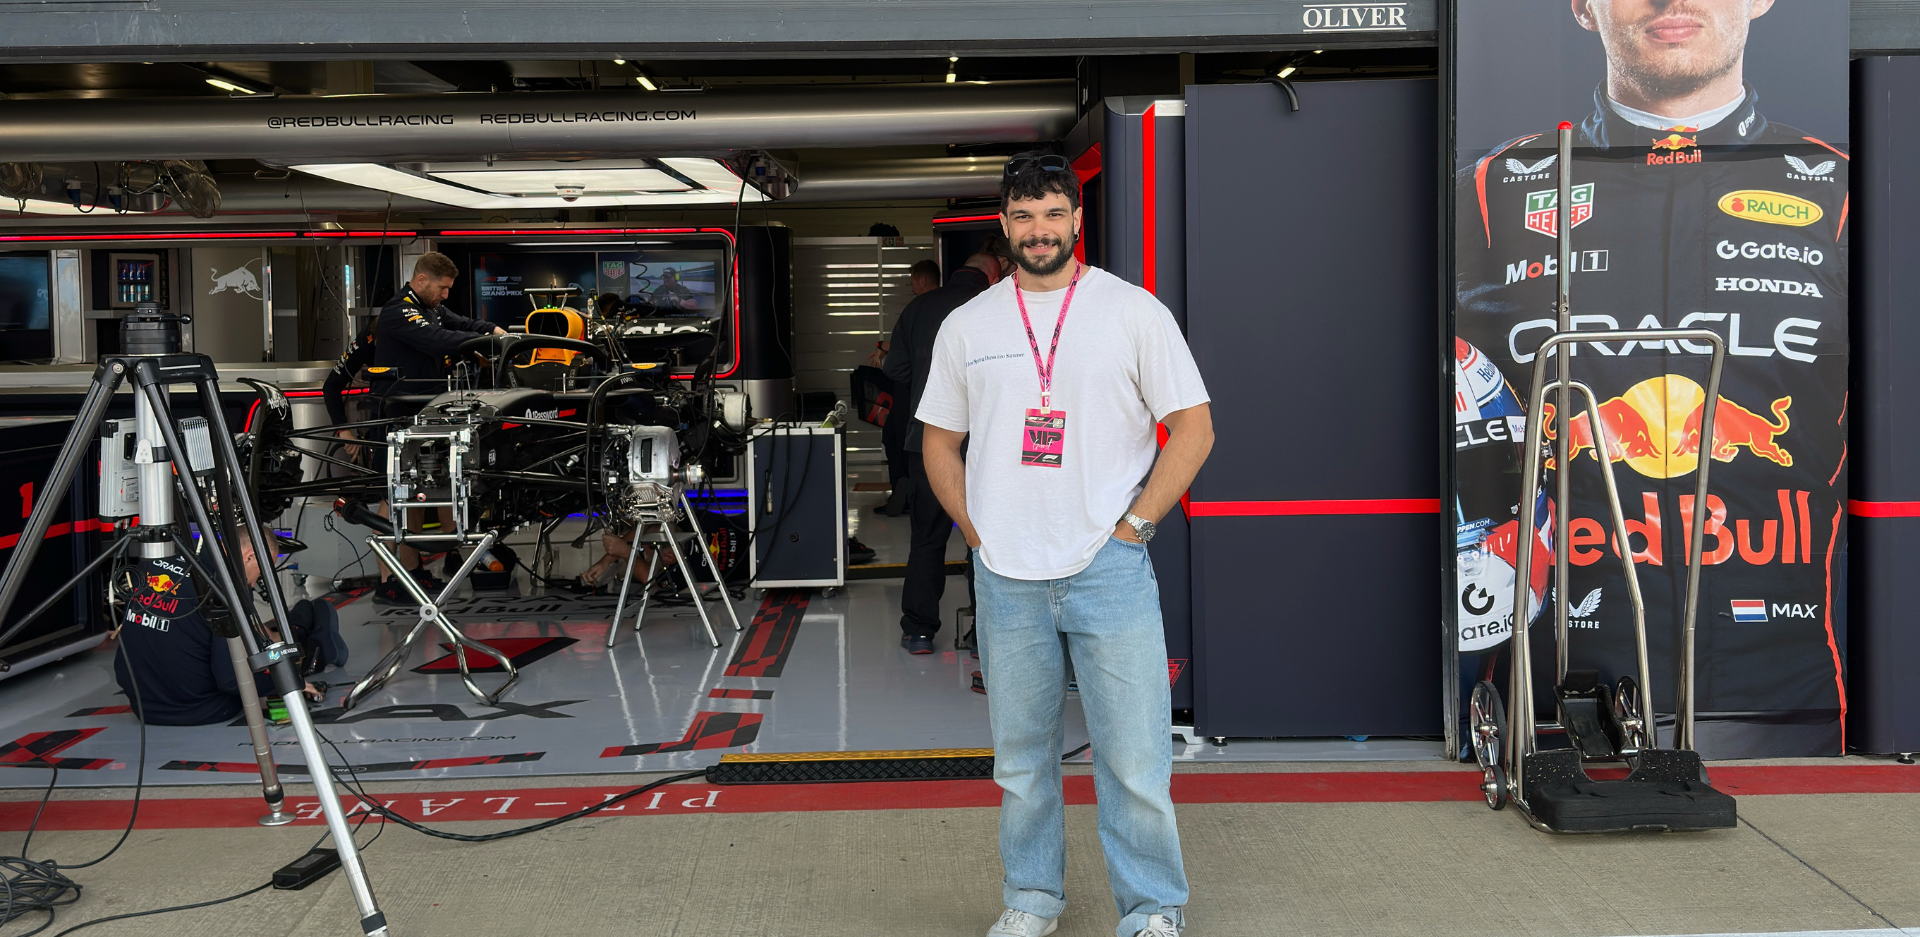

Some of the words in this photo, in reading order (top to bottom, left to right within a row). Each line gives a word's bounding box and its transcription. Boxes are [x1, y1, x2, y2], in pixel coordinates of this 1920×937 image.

[1303, 7, 1407, 28] OLIVER
[267, 114, 454, 129] @REDBULLRACING
[480, 109, 697, 125] REDBULLRACING.COM
[1647, 152, 1674, 166] Red
[1676, 149, 1702, 164] Bull
[1503, 172, 1551, 183] CASTORE
[1786, 172, 1835, 183] CASTORE
[1747, 199, 1809, 220] RAUCH
[1740, 241, 1824, 266] Gate.io
[1505, 251, 1578, 285] Mobl
[1715, 277, 1824, 298] HONDA
[1508, 311, 1822, 364] ORACLE
[1028, 429, 1062, 446] VIP
[1548, 492, 1663, 567] ed
[1679, 489, 1811, 566] Bull
[126, 608, 158, 629] Mobil
[1772, 603, 1819, 619] MAX
[1568, 620, 1600, 630] STORE
